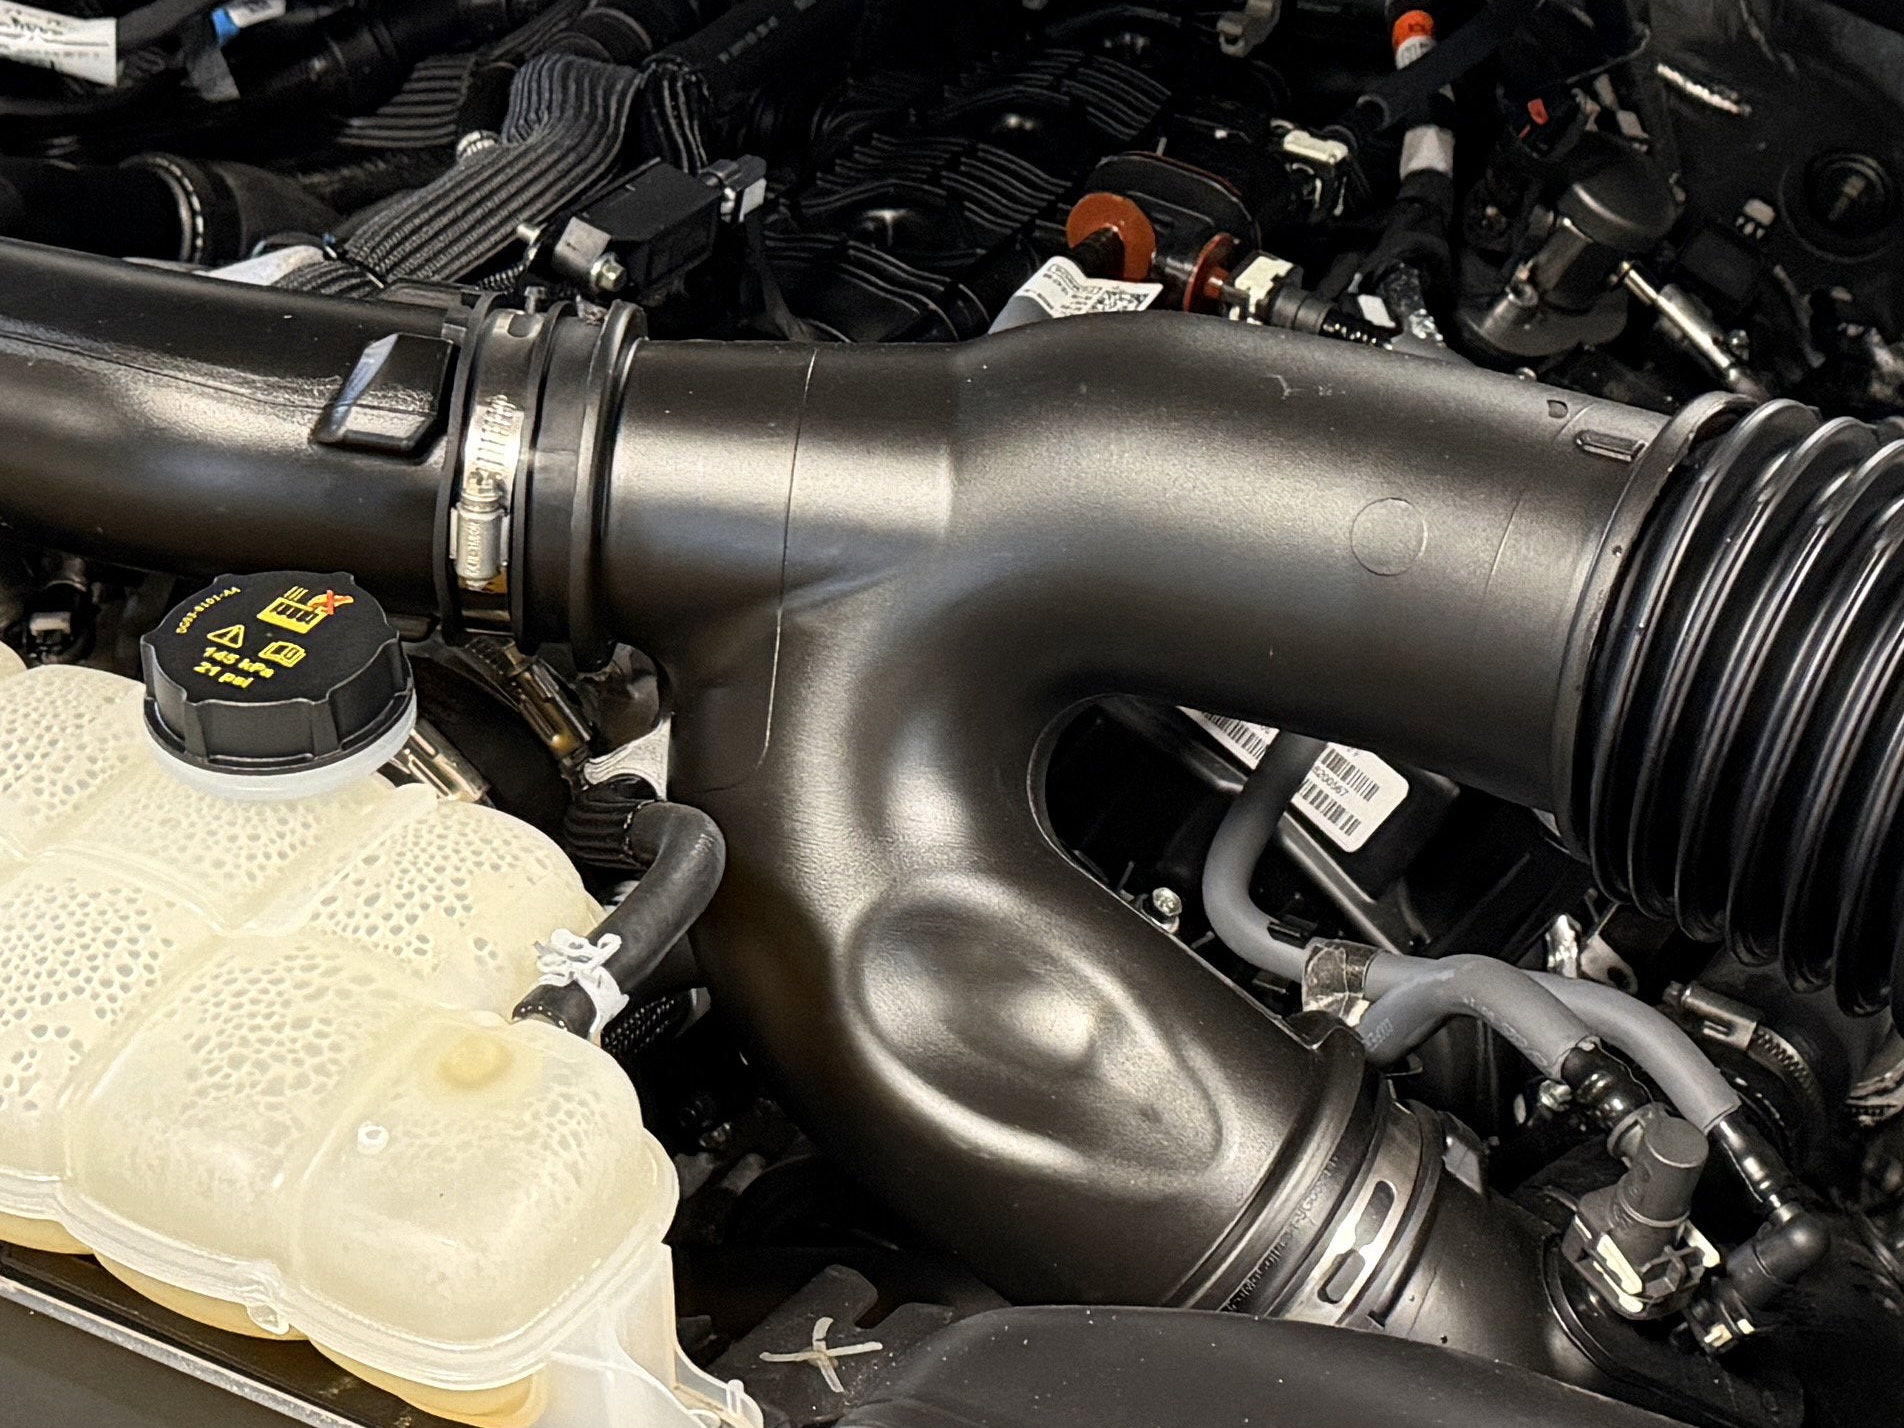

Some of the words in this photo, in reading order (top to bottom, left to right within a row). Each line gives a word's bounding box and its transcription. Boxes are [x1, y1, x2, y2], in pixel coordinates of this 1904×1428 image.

[193, 660, 222, 677] 21
[218, 672, 254, 689] psi
[203, 646, 240, 665] 145
[238, 658, 275, 679] kPa
